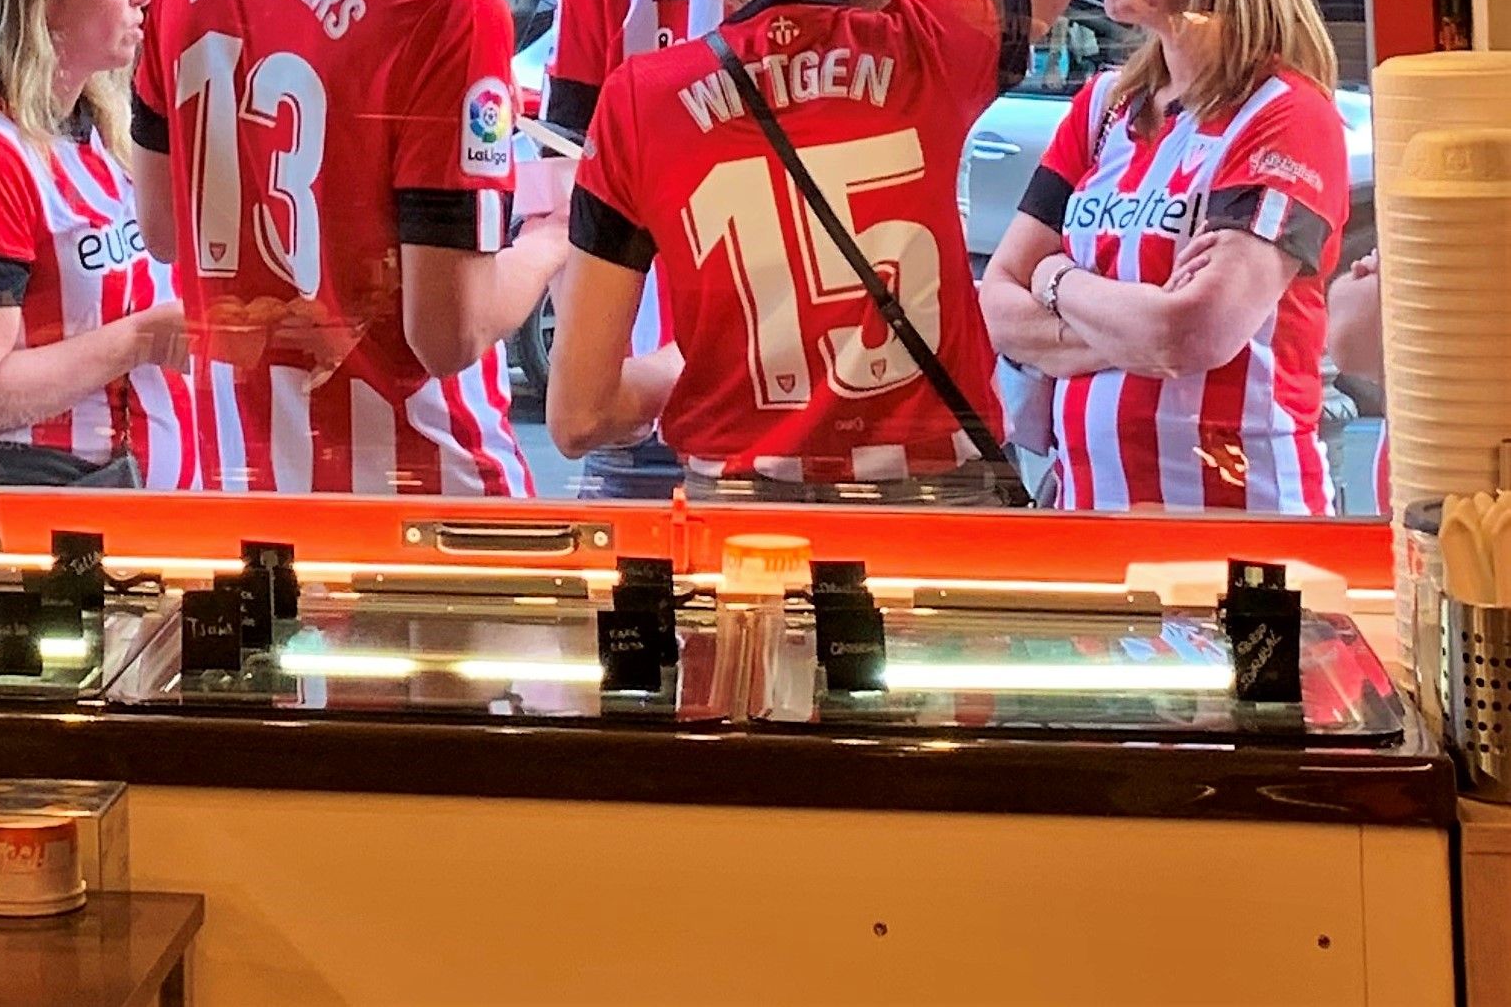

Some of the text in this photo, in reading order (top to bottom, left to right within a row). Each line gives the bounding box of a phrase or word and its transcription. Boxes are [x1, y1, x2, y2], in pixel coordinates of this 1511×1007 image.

[175, 30, 328, 301] 13
[467, 147, 507, 165] LaLiga
[1064, 189, 1202, 238] uskaltel
[680, 127, 926, 411] 15
